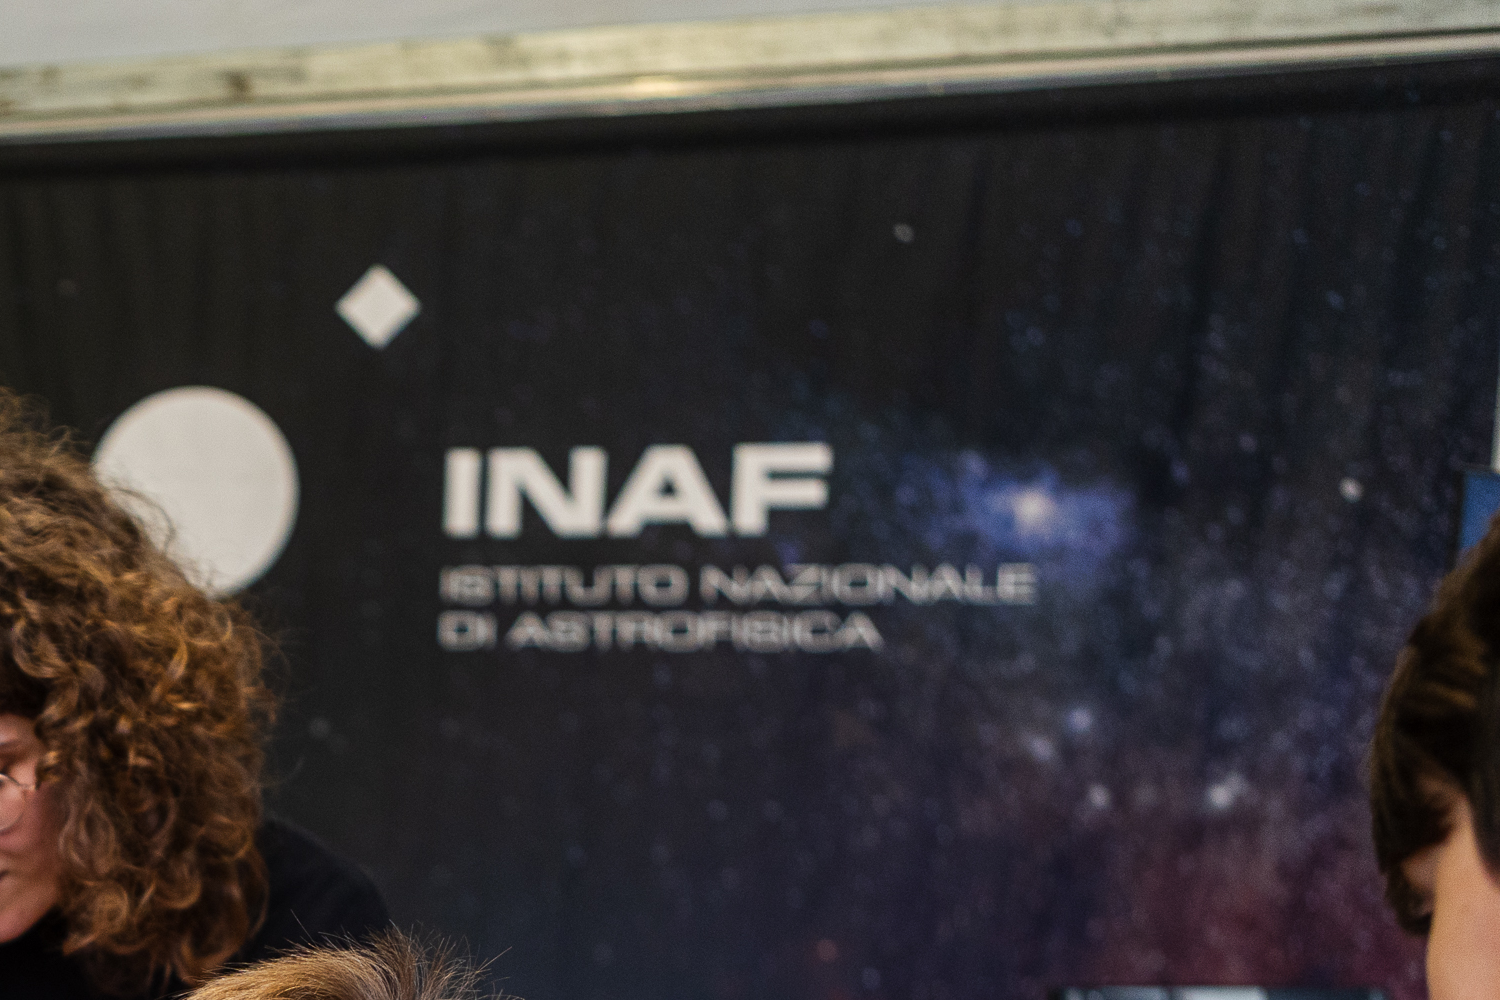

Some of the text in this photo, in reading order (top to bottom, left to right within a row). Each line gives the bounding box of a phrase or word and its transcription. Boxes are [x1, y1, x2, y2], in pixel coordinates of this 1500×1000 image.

[442, 443, 834, 540] INAF
[439, 563, 1040, 606] ISTITUTO NAZIONALE
[437, 610, 886, 652] DI ASTROFISICA
